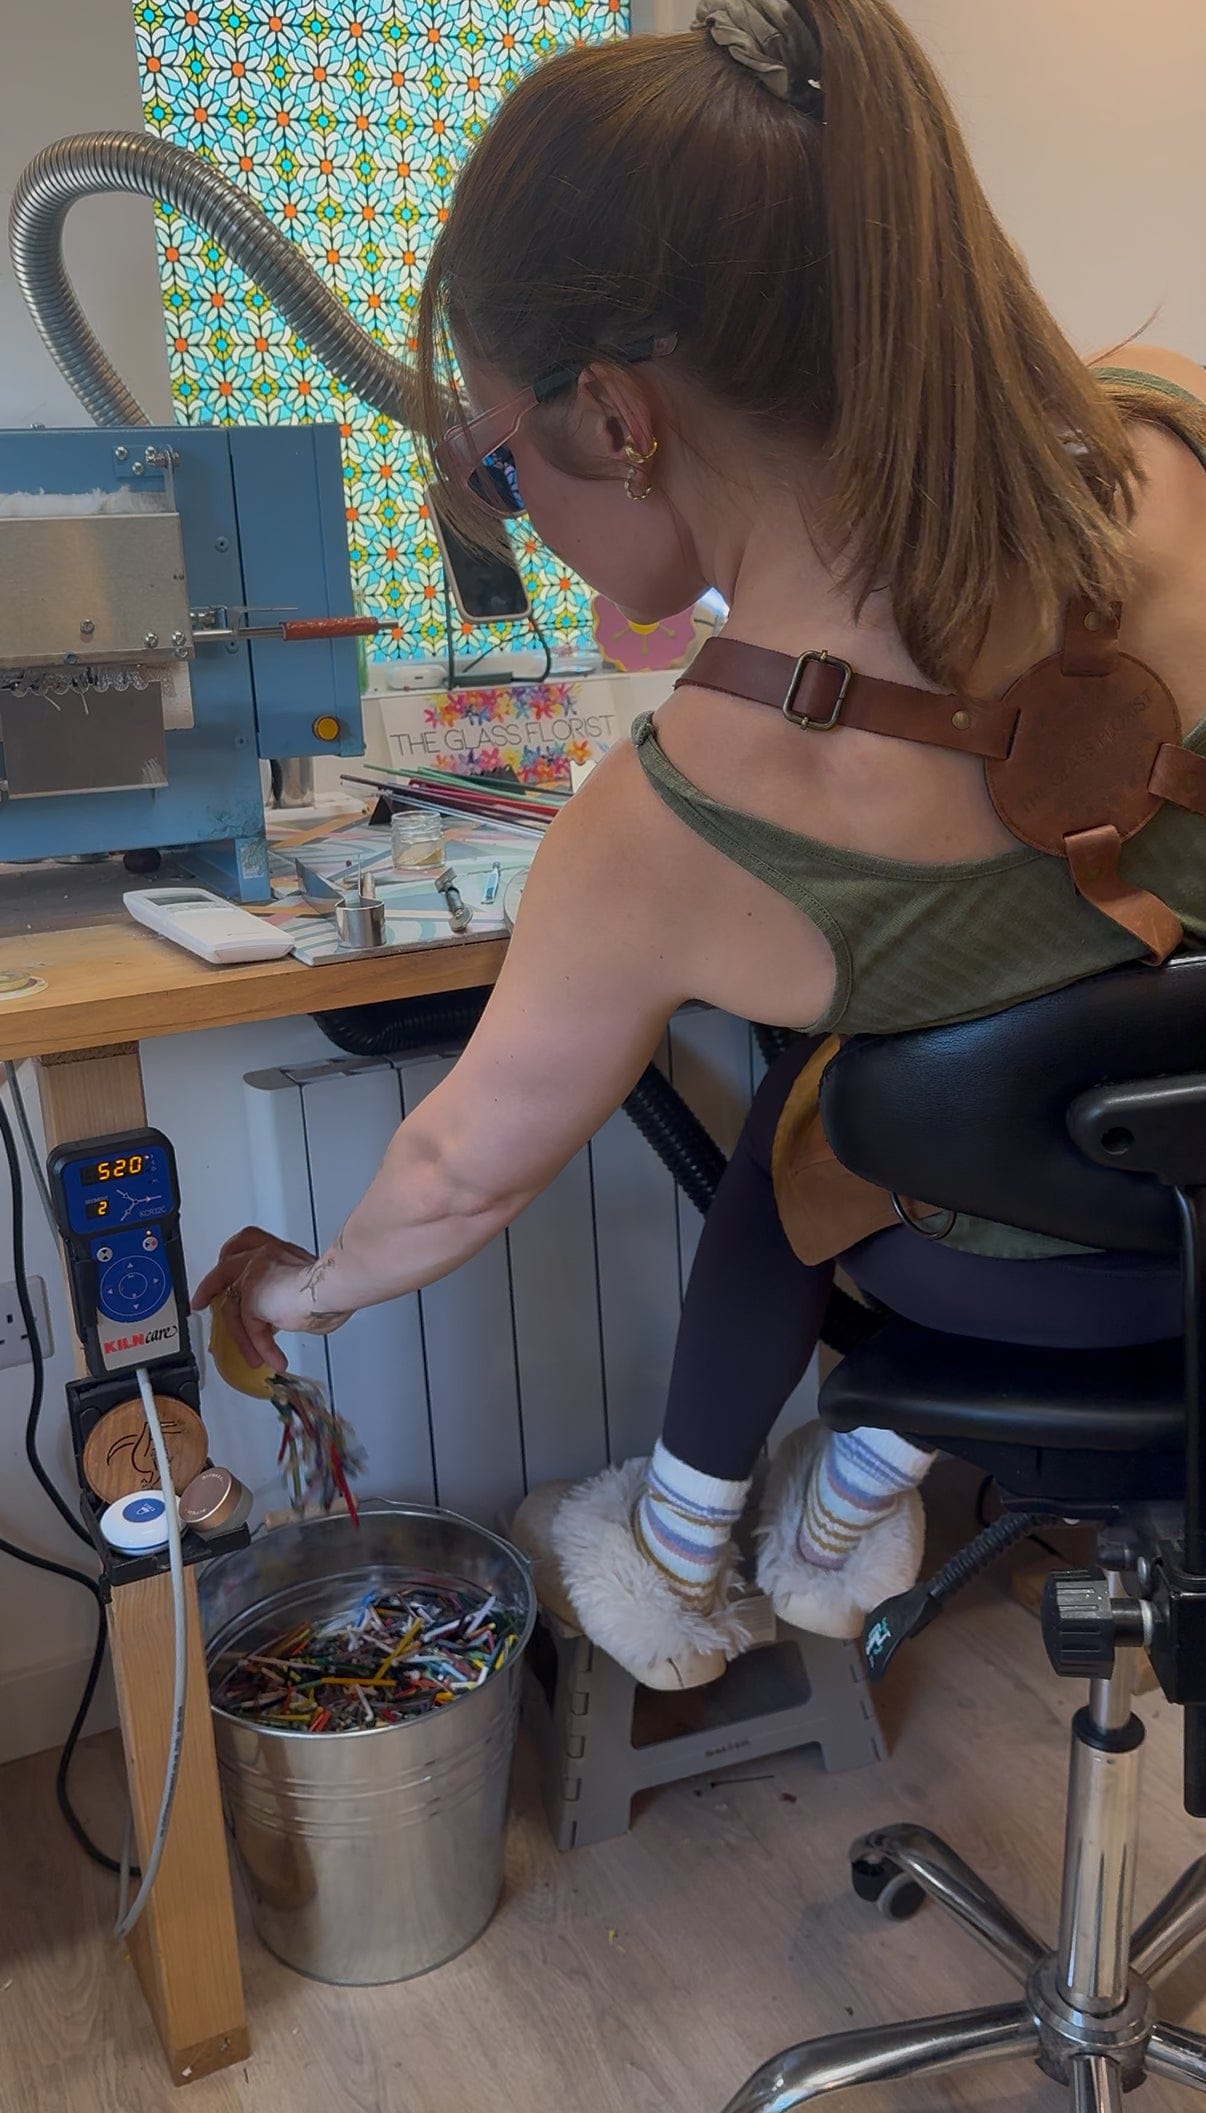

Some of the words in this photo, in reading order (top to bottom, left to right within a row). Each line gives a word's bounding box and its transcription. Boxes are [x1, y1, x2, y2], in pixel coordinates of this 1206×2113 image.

[390, 731, 440, 755] THE
[444, 724, 522, 750] GLASS
[526, 715, 615, 744] FLORIST
[97, 1156, 142, 1180] 520
[98, 1201, 107, 1215] 2
